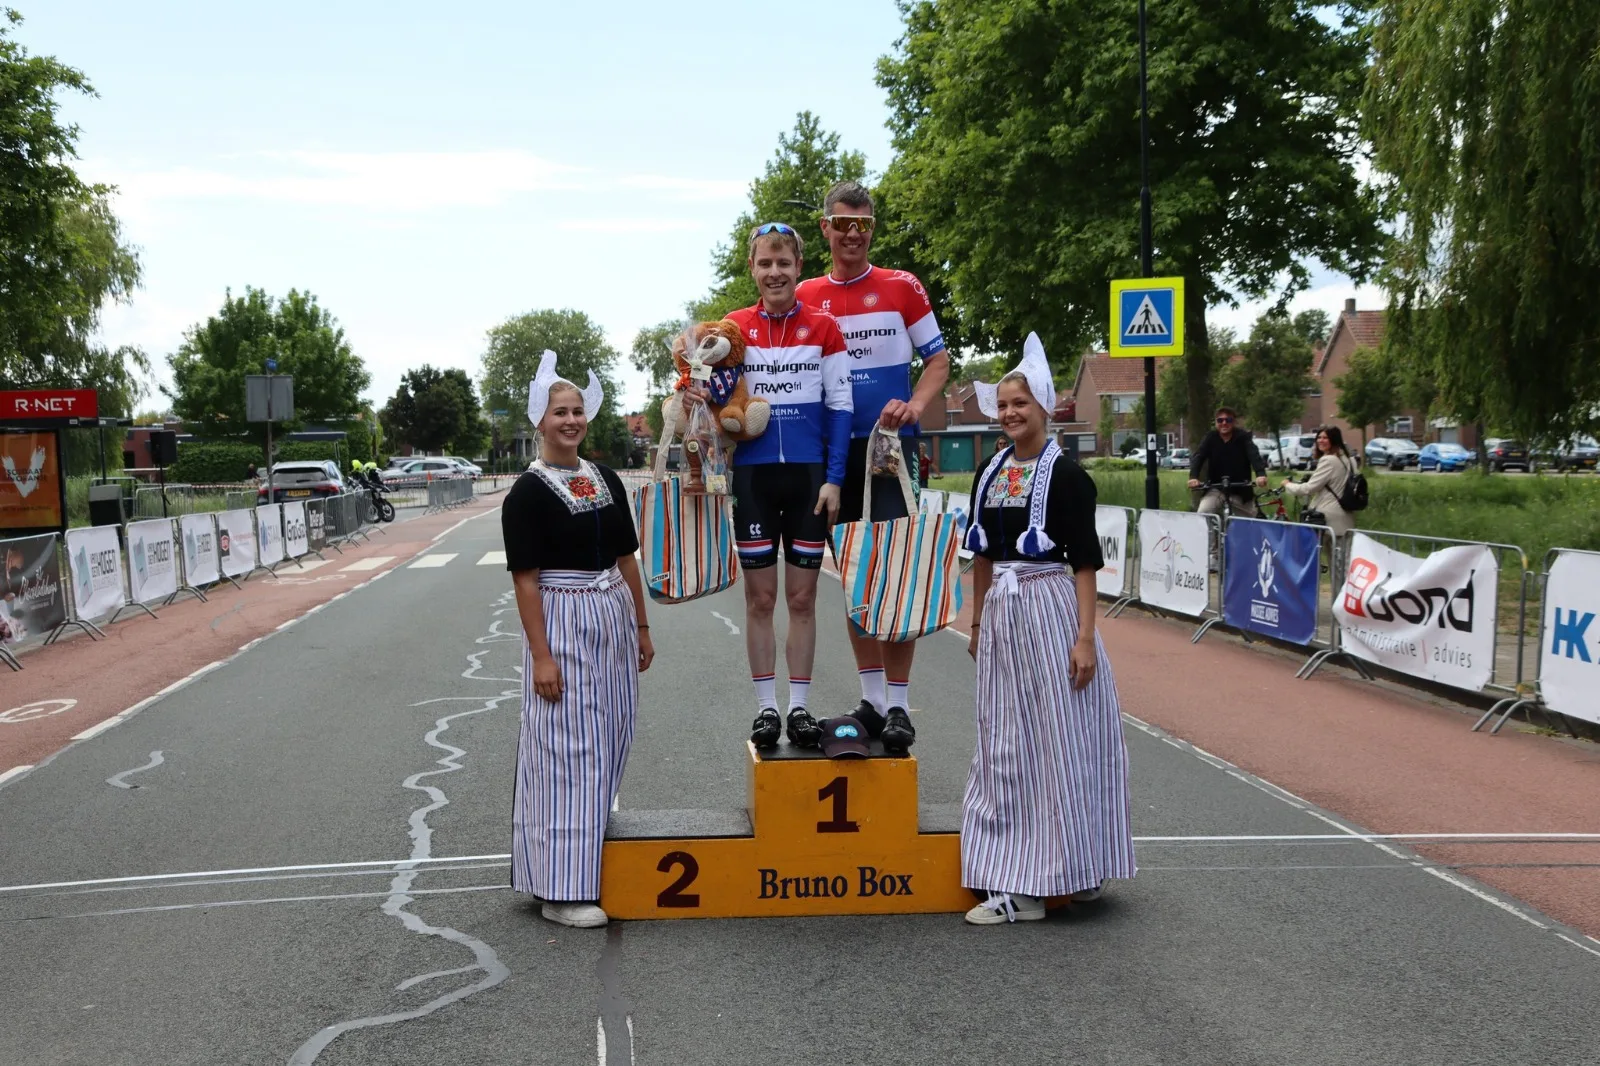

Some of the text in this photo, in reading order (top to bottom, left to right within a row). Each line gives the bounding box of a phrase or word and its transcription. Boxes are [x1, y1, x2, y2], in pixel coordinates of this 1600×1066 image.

[1175, 570, 1183, 587] de
[1184, 571, 1205, 591] Zedde
[1367, 569, 1475, 633] bond
[1434, 642, 1472, 668] advies
[816, 776, 861, 833] 1
[656, 851, 700, 908] 2
[757, 866, 915, 900] Bruno Box
